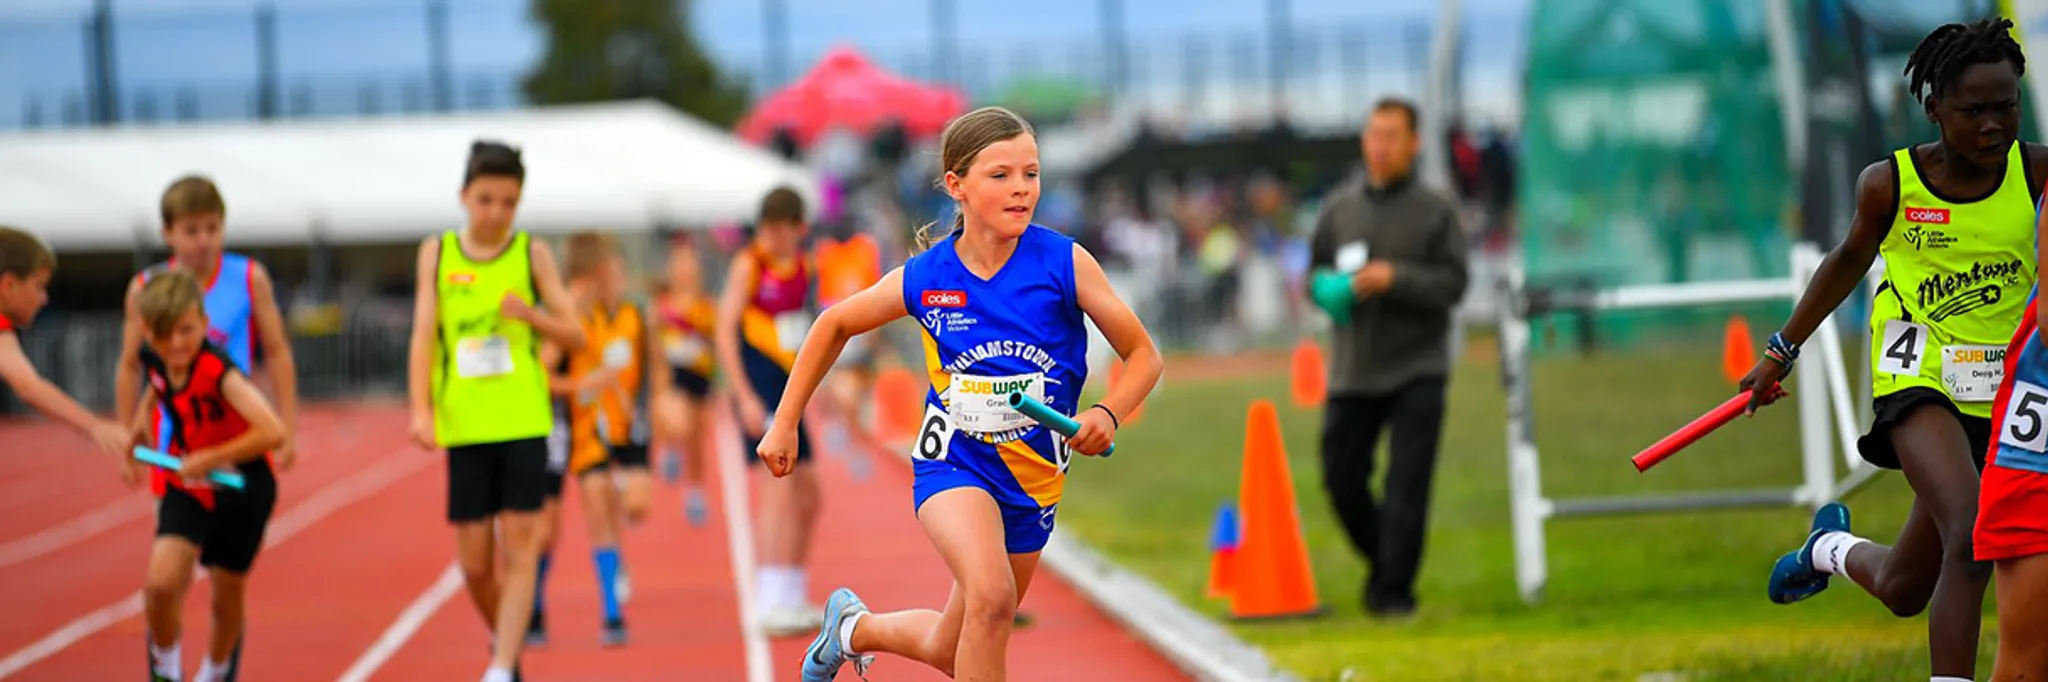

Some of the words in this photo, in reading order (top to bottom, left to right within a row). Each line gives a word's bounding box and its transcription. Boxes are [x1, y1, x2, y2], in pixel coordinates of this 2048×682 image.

[1910, 210, 1944, 222] coles
[928, 293, 961, 305] coles
[1917, 259, 2022, 310] Mentone
[1886, 326, 1918, 369] 4
[1952, 349, 2006, 363] SUBWA
[959, 379, 1034, 396] SUBWAY
[2011, 391, 2048, 442] 5
[919, 415, 947, 460] 6
